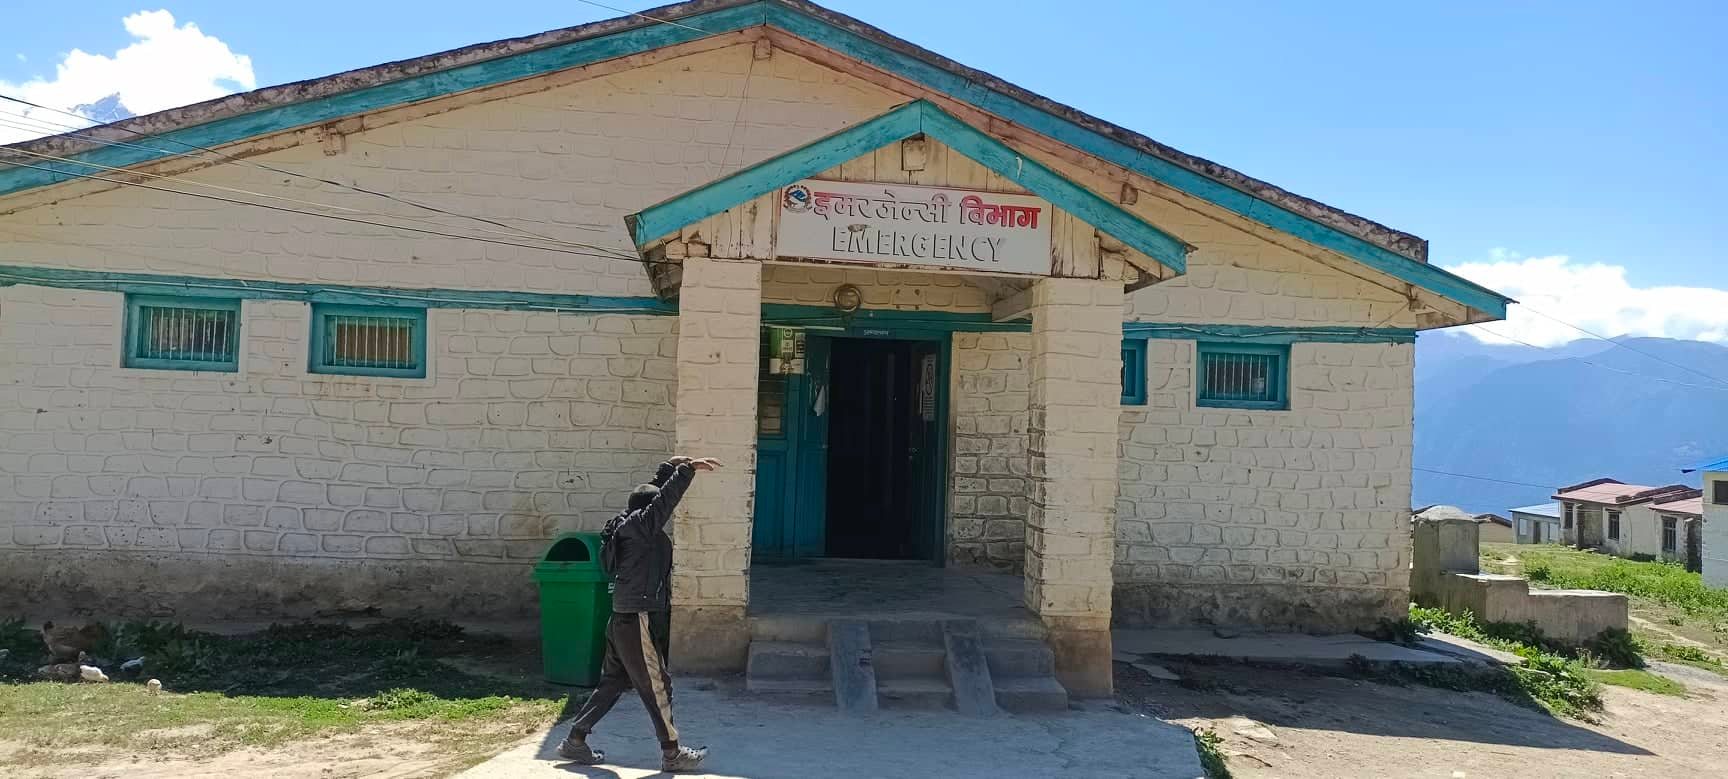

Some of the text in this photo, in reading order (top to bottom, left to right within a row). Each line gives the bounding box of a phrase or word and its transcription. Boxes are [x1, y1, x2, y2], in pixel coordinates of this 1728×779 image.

[812, 190, 1041, 229] इमरजेन्सी विभाग
[831, 226, 1003, 263] EMERGENCY
